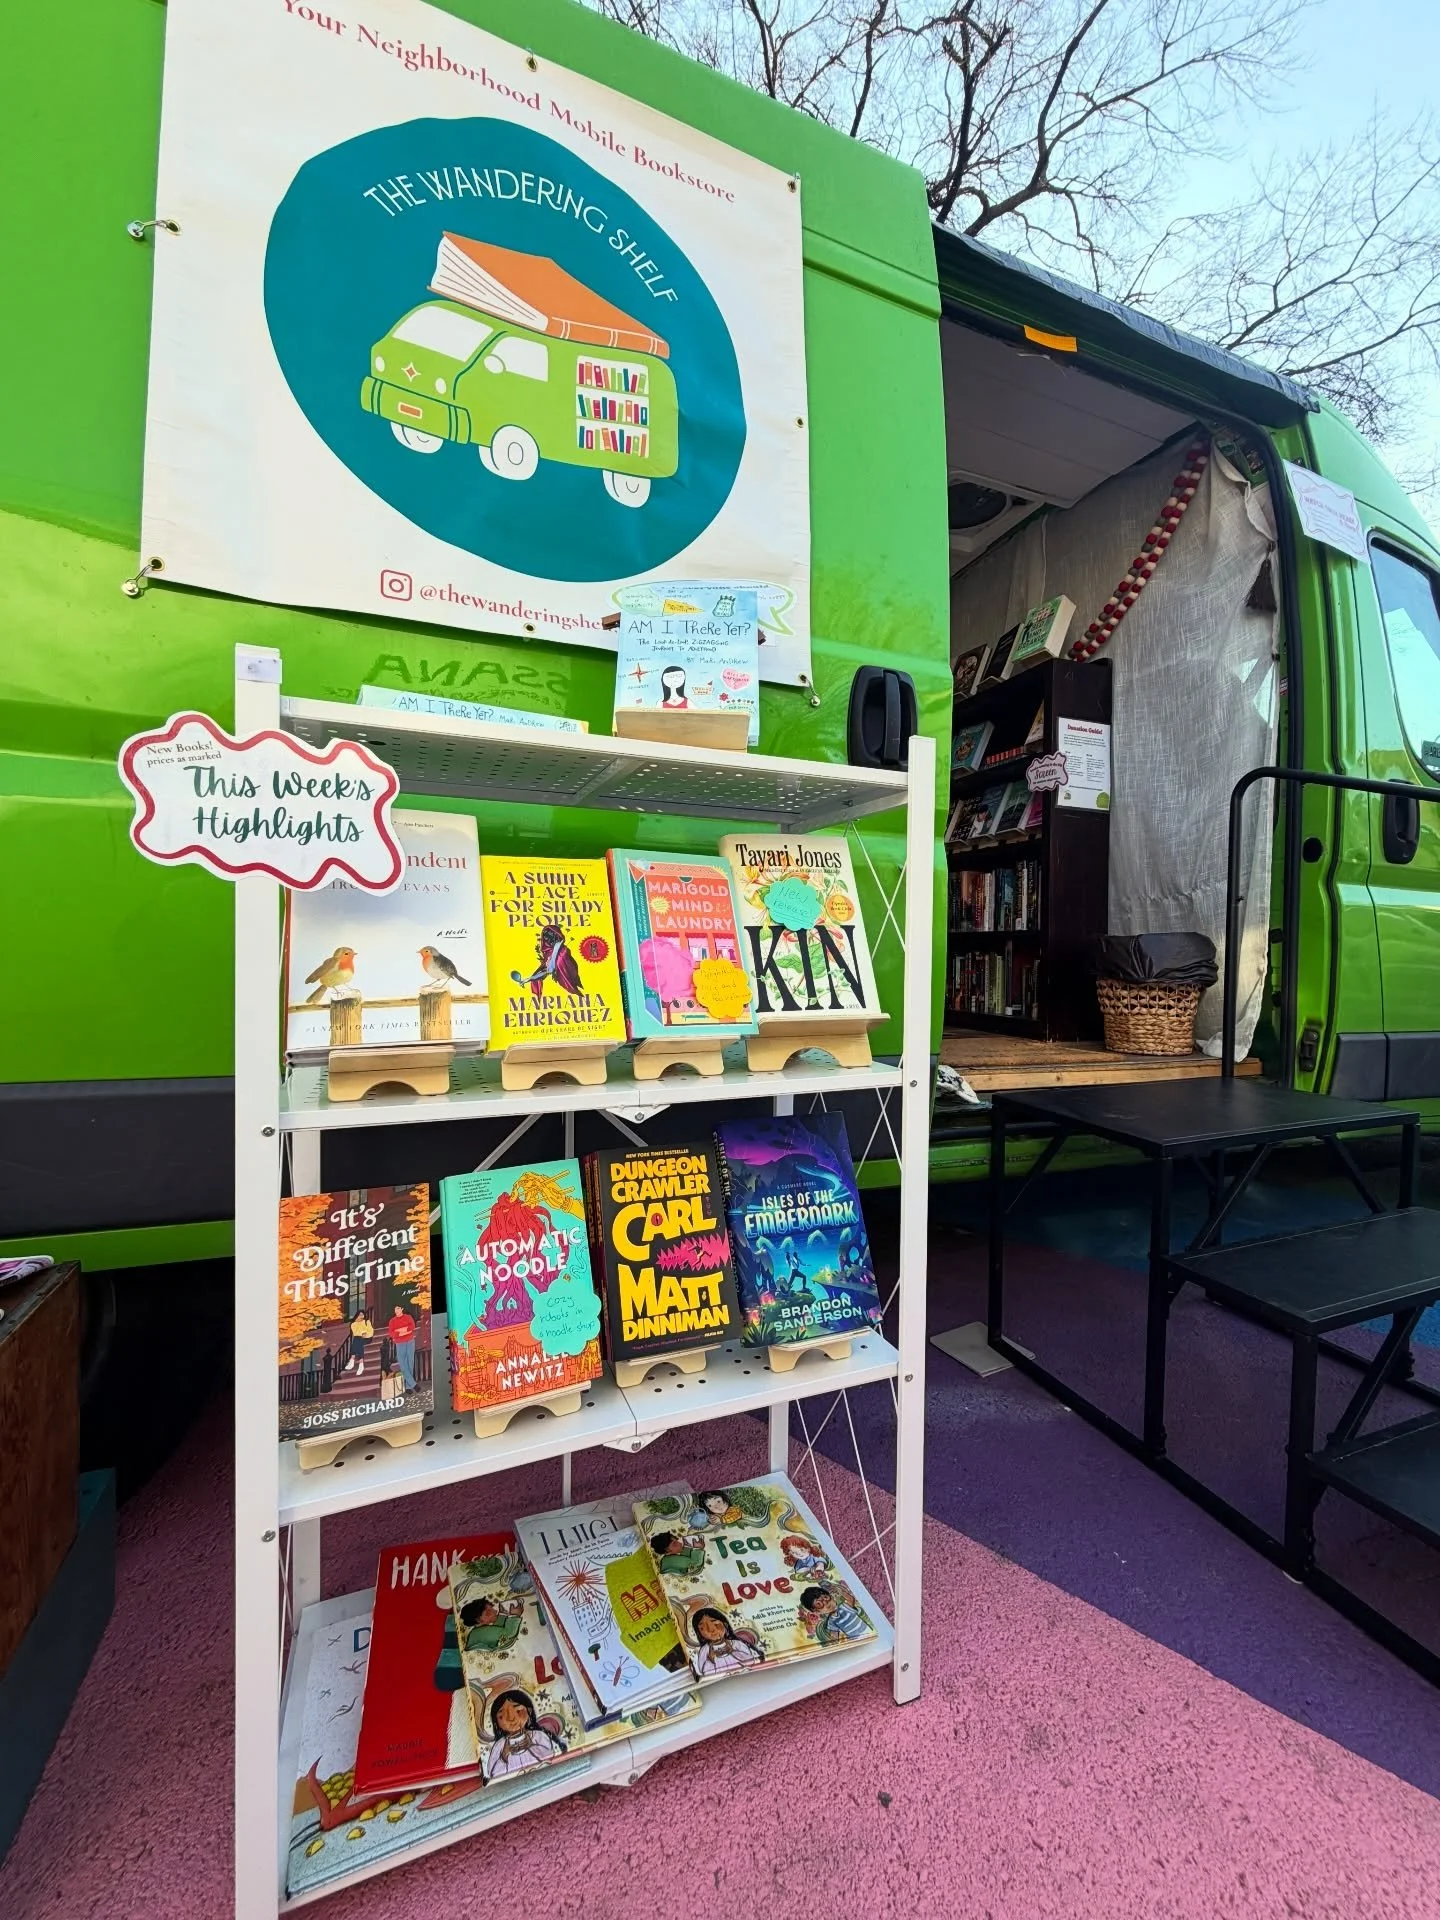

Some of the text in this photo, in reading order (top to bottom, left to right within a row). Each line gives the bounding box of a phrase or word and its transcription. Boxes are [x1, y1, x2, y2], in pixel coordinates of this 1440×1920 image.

[284, 0, 736, 203] Your Neighborhood Mobile Bookstore
[363, 165, 680, 303] THE WANDERING SHELF
[420, 583, 610, 631] @thewanderingshe
[628, 620, 653, 634] AM
[661, 620, 674, 634] I
[399, 696, 419, 712] AM
[425, 698, 437, 714] I
[146, 741, 214, 756] New Books!
[146, 755, 174, 767] prices
[188, 751, 223, 762] marked
[183, 764, 375, 801] This Week's
[193, 806, 364, 846] Highlights
[735, 843, 843, 873] Tayari Jones
[404, 883, 450, 893] EVANS
[504, 871, 588, 886] A SUNNY
[649, 881, 729, 897] MARIGOLD
[516, 886, 580, 899] PLACE
[490, 900, 604, 913] FOR SHADY
[671, 899, 714, 913] MIND
[508, 914, 592, 928] PEOPLE
[655, 917, 733, 931] LAUNDRY
[744, 924, 868, 1014] KIN
[509, 993, 606, 1012] MARIANA
[381, 1021, 410, 1030] TIMES
[504, 1008, 613, 1028] ENRIQUEZ
[664, 1148, 689, 1156] BESTSELLER
[610, 1154, 707, 1182] DUNGEON
[611, 1173, 711, 1203] CRAWLER
[762, 1189, 834, 1211] ISLES OF THE
[330, 1202, 385, 1231] It's
[611, 1195, 717, 1262] CARL
[745, 1201, 858, 1238] EMBERDARK
[292, 1223, 419, 1273] Different
[460, 1226, 582, 1265] AUTOMATIC
[283, 1254, 425, 1303] This Time
[479, 1252, 568, 1286] NOODLE
[617, 1263, 724, 1320] MATT
[539, 1309, 569, 1325] robots
[773, 1307, 862, 1332] SANDERSON
[781, 1298, 851, 1318] BRANDON
[545, 1321, 574, 1339] noodle
[576, 1319, 595, 1337] shop
[623, 1304, 730, 1342] DINNIMAN
[501, 1363, 564, 1390] NEWITZ
[303, 1396, 405, 1429] JOSS RICHARD
[709, 1535, 767, 1559] Tea
[391, 1548, 466, 1590] HANK
[736, 1560, 761, 1578] Is
[721, 1577, 794, 1605] Love
[767, 1607, 795, 1617] Khorram
[763, 1624, 785, 1632] Hanna
